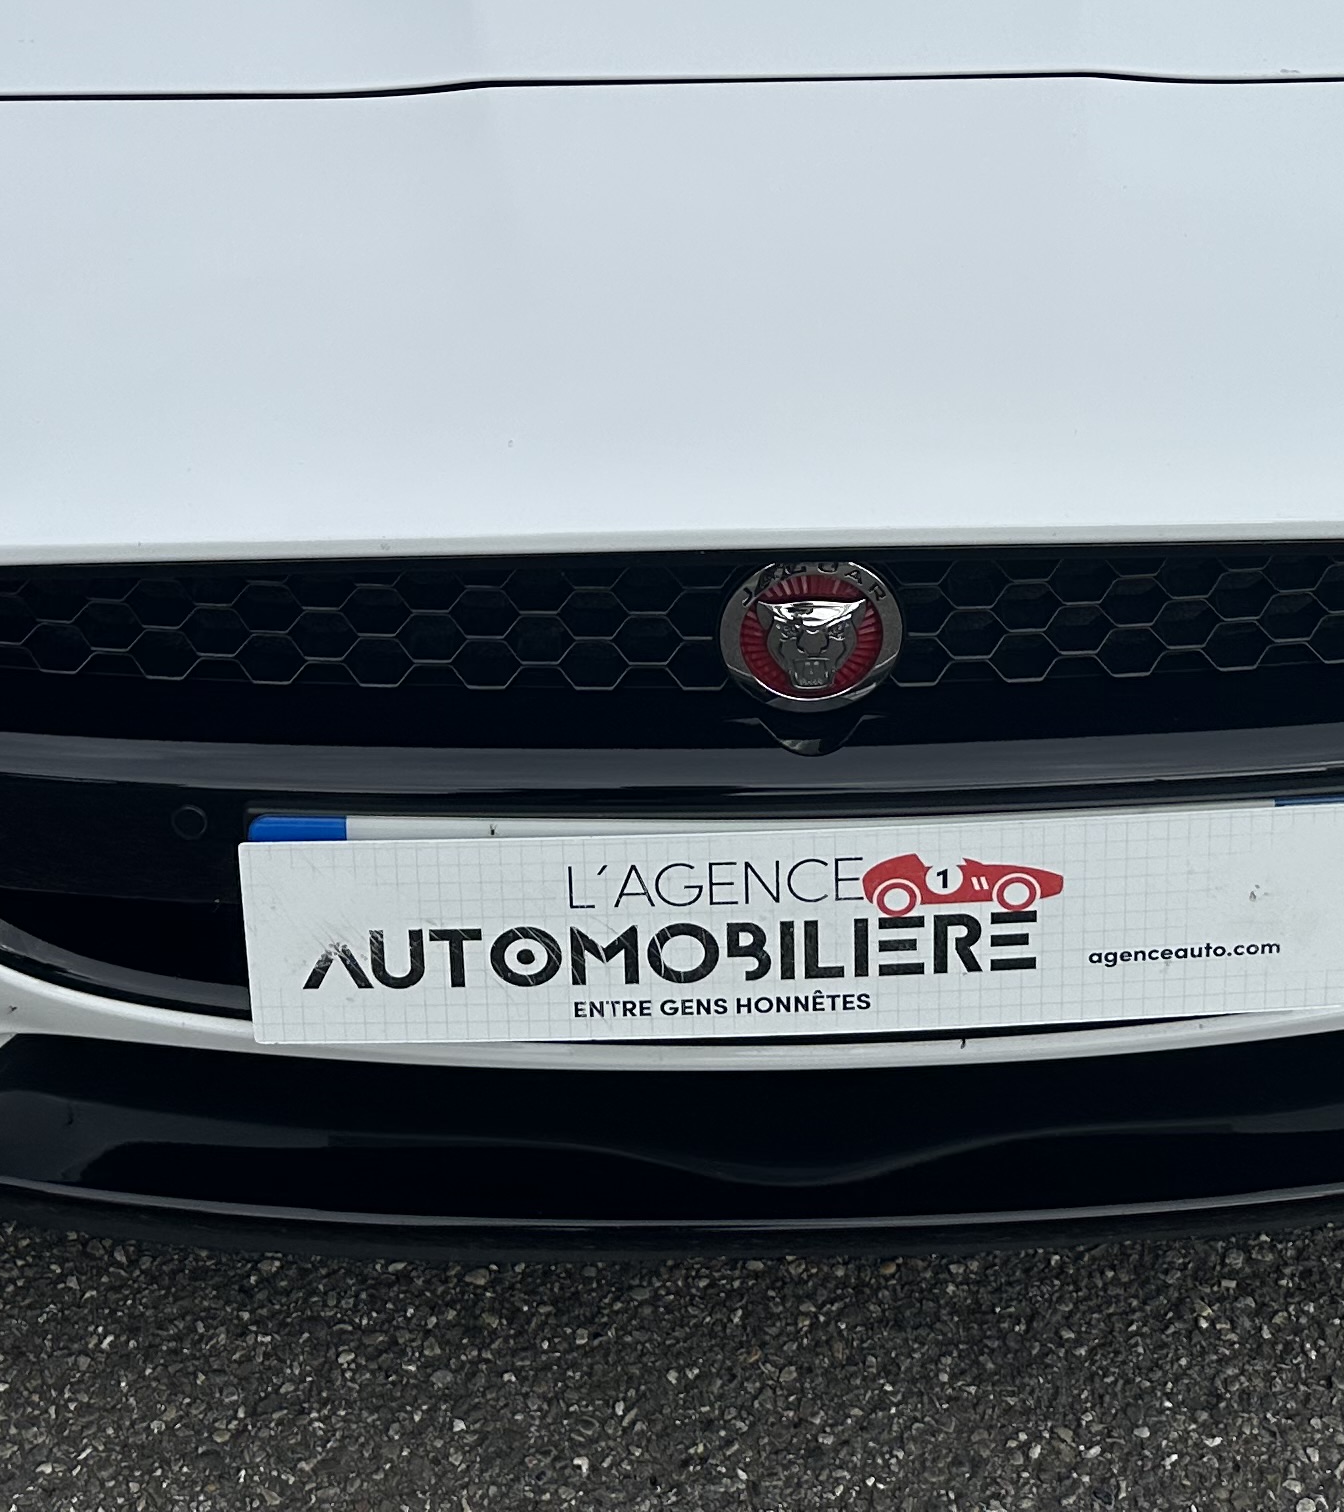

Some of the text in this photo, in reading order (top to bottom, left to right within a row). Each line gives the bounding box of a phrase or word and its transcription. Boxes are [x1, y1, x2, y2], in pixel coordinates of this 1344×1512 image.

[568, 857, 864, 909] L'AGENCE
[936, 868, 949, 889] 1
[1088, 940, 1281, 968] agenceauto.com
[573, 989, 872, 1018] ENTRE GENS HONNÊTES
